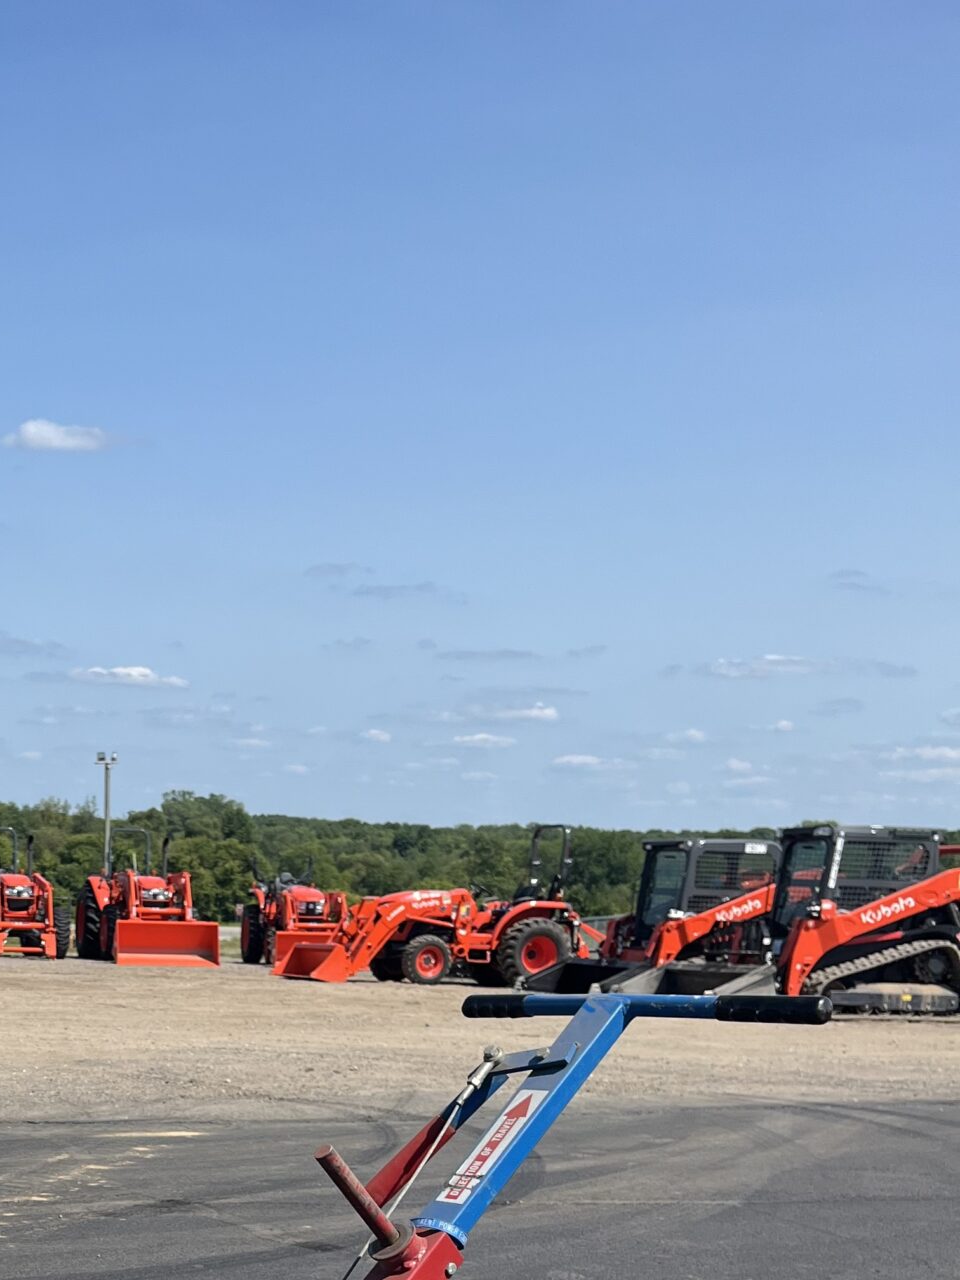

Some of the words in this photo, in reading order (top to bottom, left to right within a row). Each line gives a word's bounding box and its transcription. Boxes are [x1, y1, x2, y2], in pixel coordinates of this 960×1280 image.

[715, 899, 762, 921] Kubota
[860, 896, 916, 924] Kubota
[480, 1146, 493, 1156] OF
[491, 1117, 517, 1141] TRAVEL
